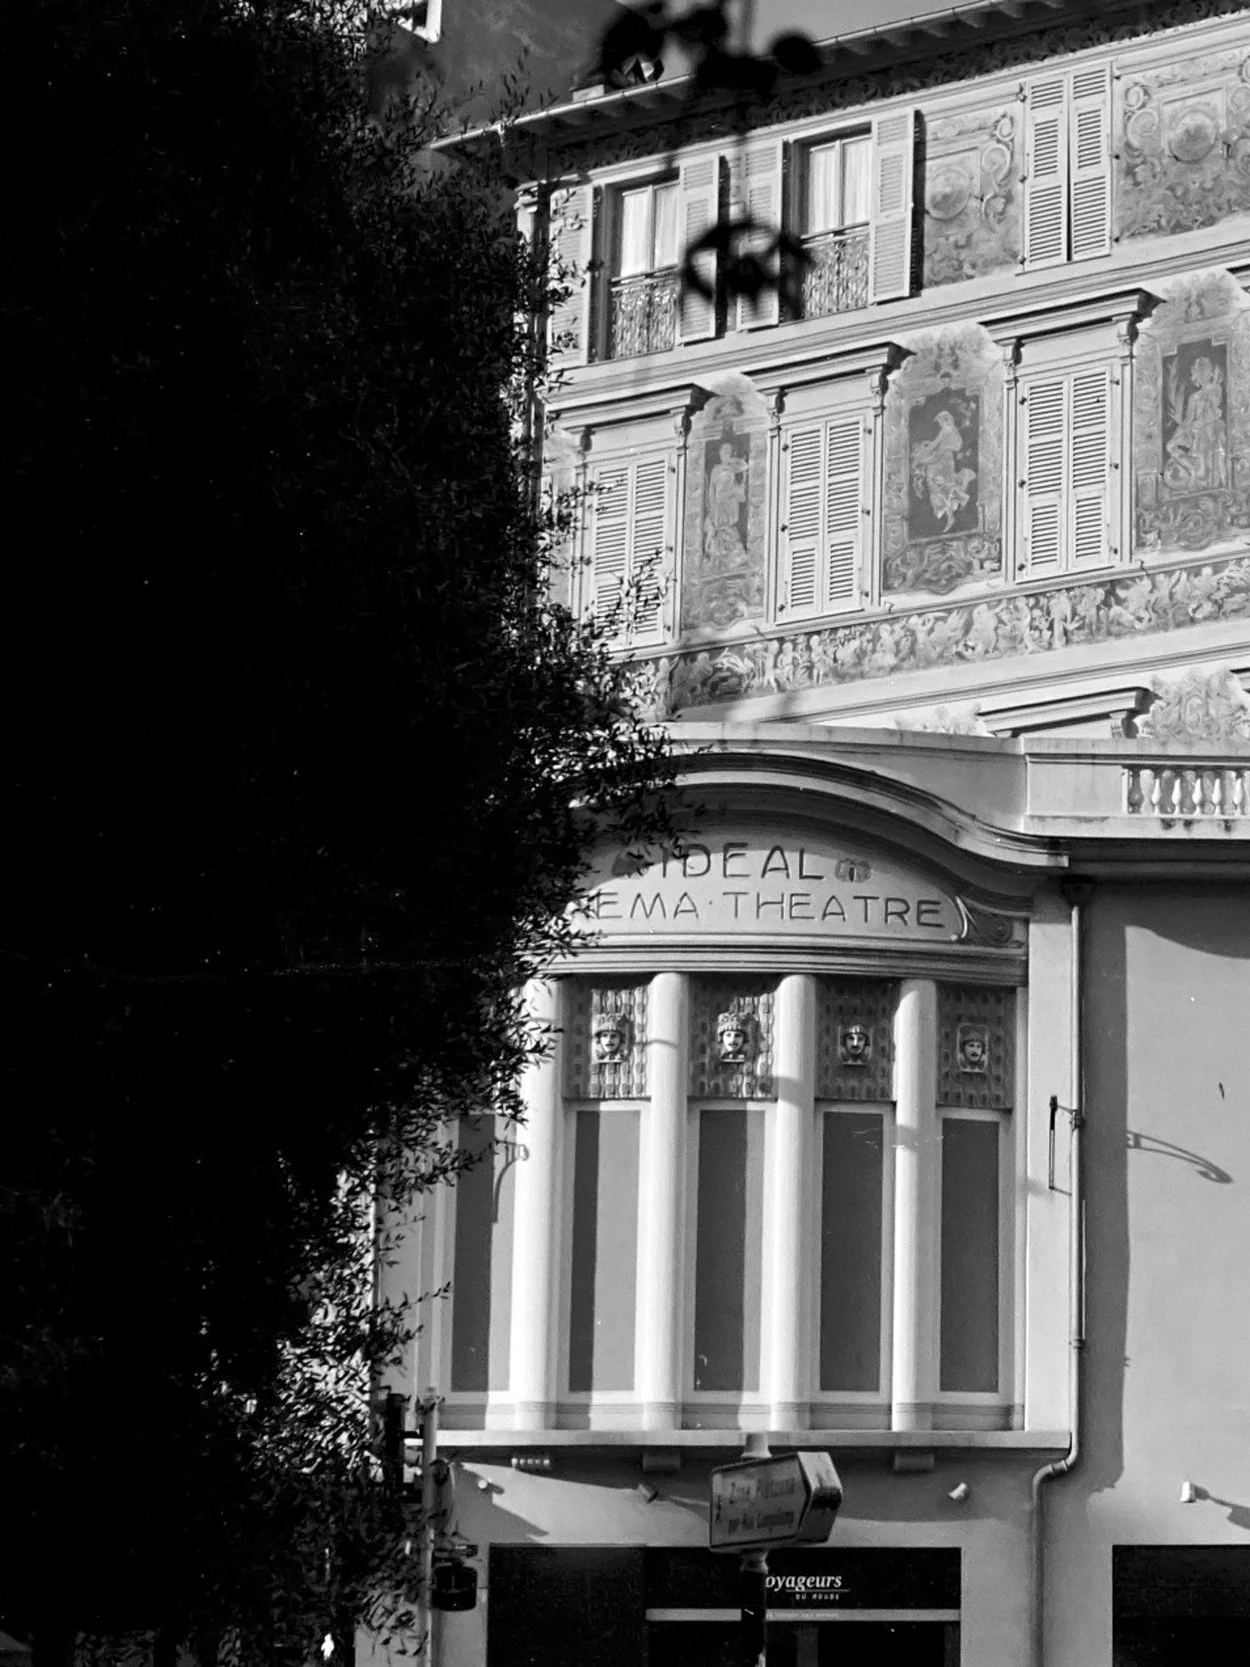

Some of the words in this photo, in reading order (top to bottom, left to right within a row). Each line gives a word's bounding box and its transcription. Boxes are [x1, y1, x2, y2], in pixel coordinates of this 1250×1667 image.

[659, 842, 824, 881] IDEAL
[596, 891, 700, 920] EMA
[721, 891, 945, 928] THEATRE
[765, 1575, 842, 1592] oyageurs
